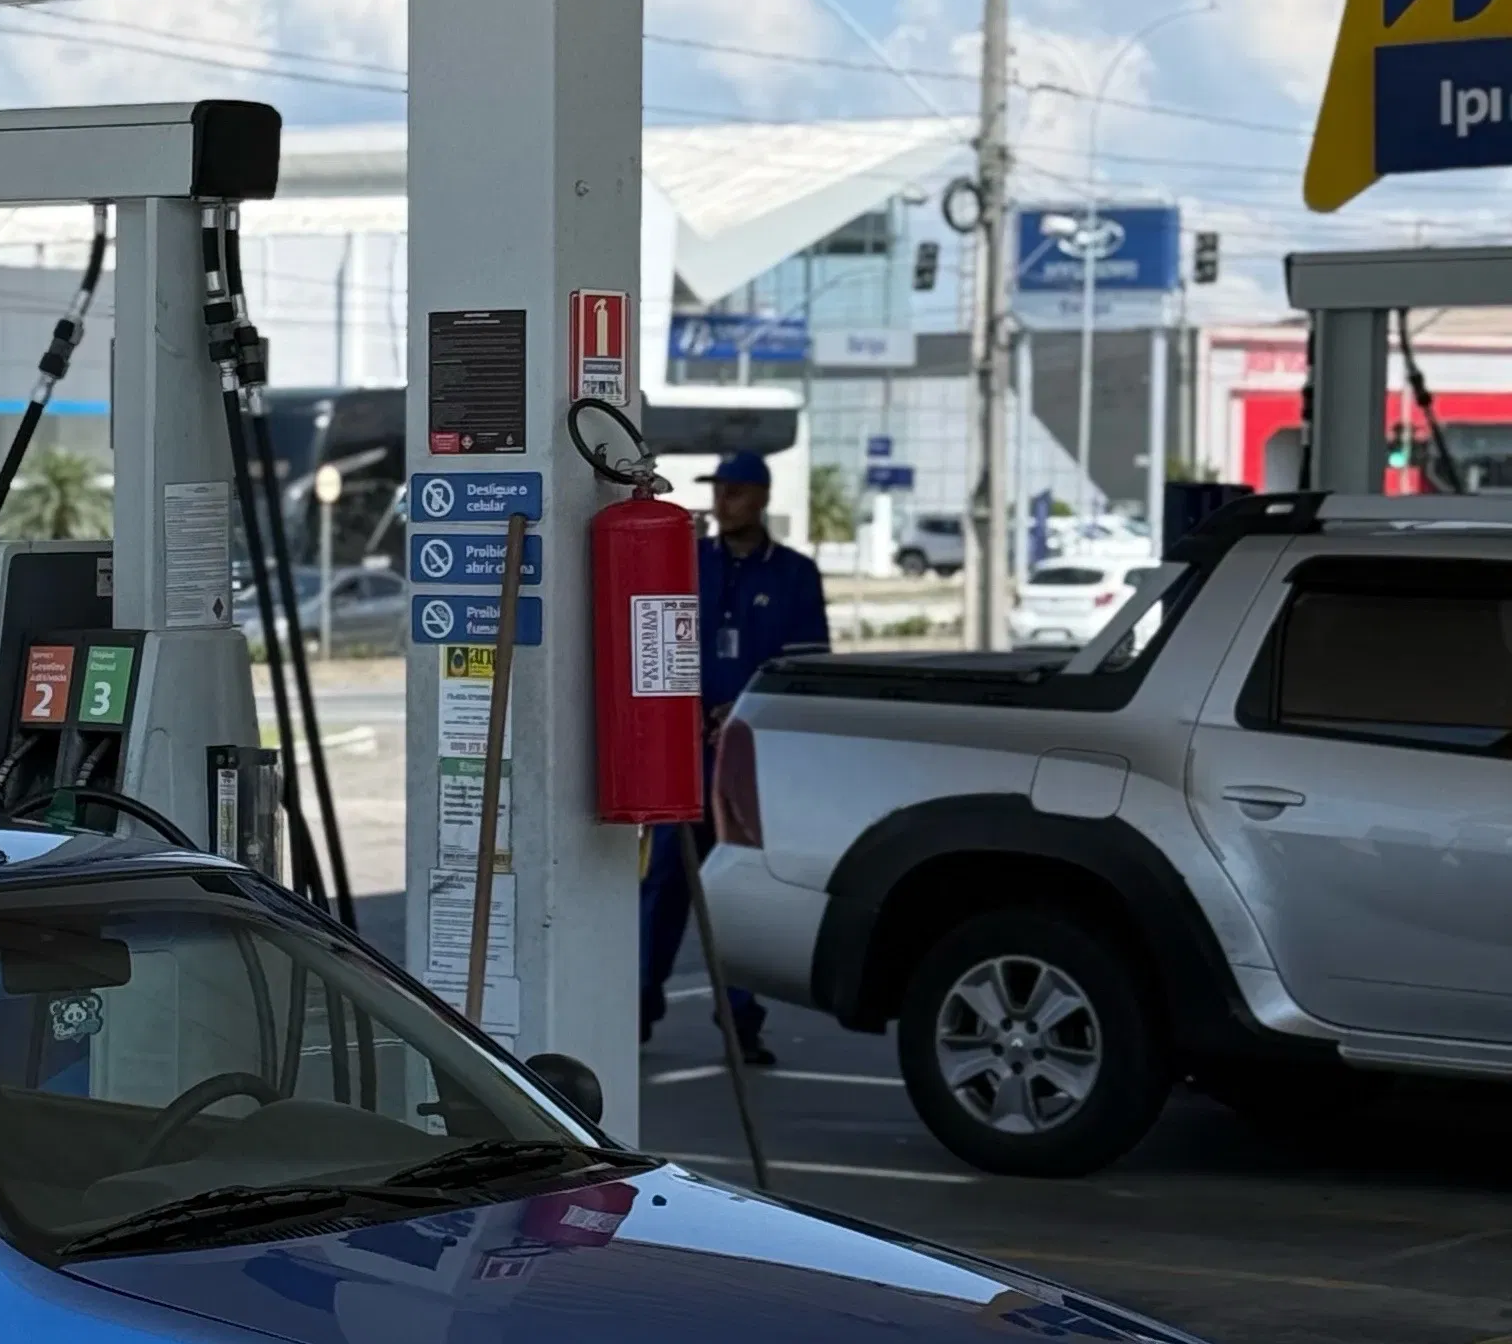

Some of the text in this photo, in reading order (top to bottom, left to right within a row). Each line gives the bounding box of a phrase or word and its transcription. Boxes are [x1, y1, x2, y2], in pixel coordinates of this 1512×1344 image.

[1440, 79, 1512, 137] Ipi
[467, 483, 517, 498] Desligue
[467, 500, 506, 513] celular
[466, 545, 507, 558] Proibid
[466, 606, 500, 620] Proibi
[467, 622, 499, 635] fuma
[31, 683, 53, 717] 2
[89, 681, 112, 716] 3
